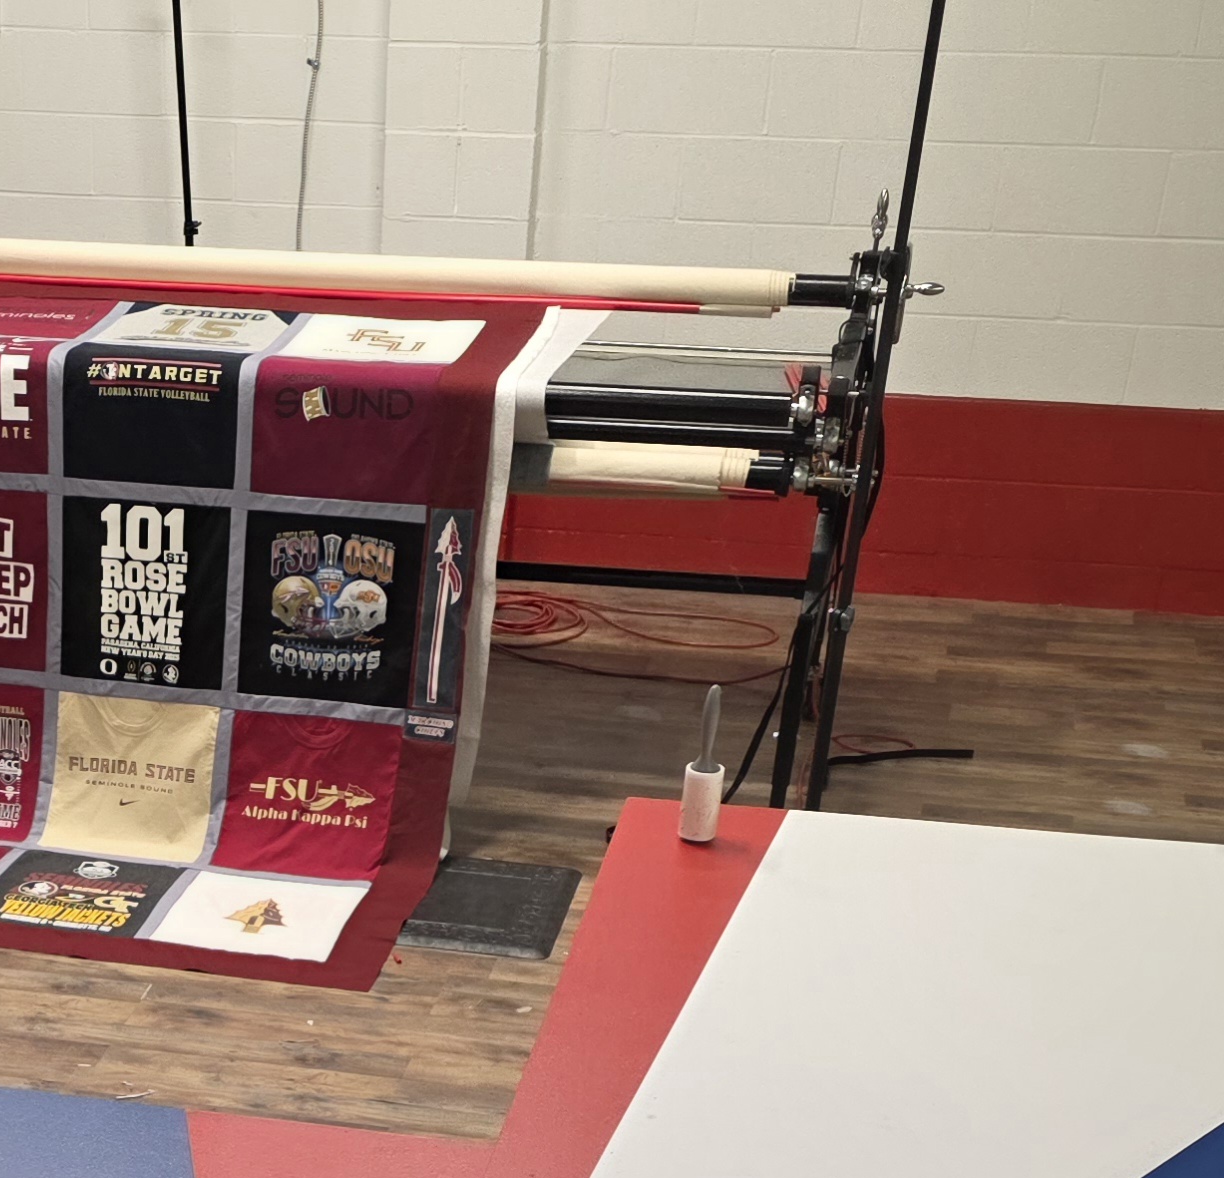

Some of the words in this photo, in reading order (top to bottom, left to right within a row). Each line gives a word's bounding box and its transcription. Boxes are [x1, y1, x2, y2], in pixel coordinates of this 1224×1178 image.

[161, 307, 269, 322] SPRING
[150, 318, 248, 340] 15
[347, 328, 426, 352] FSU
[98, 386, 132, 397] FLORIDA
[133, 387, 160, 398] STATE
[161, 389, 211, 402] VOLLEYBALL
[101, 503, 185, 561] 101
[271, 536, 319, 577] FSU
[343, 539, 395, 583] OSU
[101, 559, 188, 594] ROSE
[101, 588, 184, 618] BOWL
[101, 613, 183, 645] GAME
[270, 643, 381, 673] COWBOYS
[68, 756, 138, 776] FLORIDA
[145, 763, 196, 784] STATE
[85, 779, 135, 789] SEMINOLE
[264, 776, 322, 801] FSU
[241, 805, 288, 821] Alpha
[291, 809, 342, 826] Kappa
[344, 814, 368, 829] Psi
[4, 893, 58, 906] GEORGIA
[57, 899, 94, 911] TECH
[57, 906, 132, 928] JACKETS
